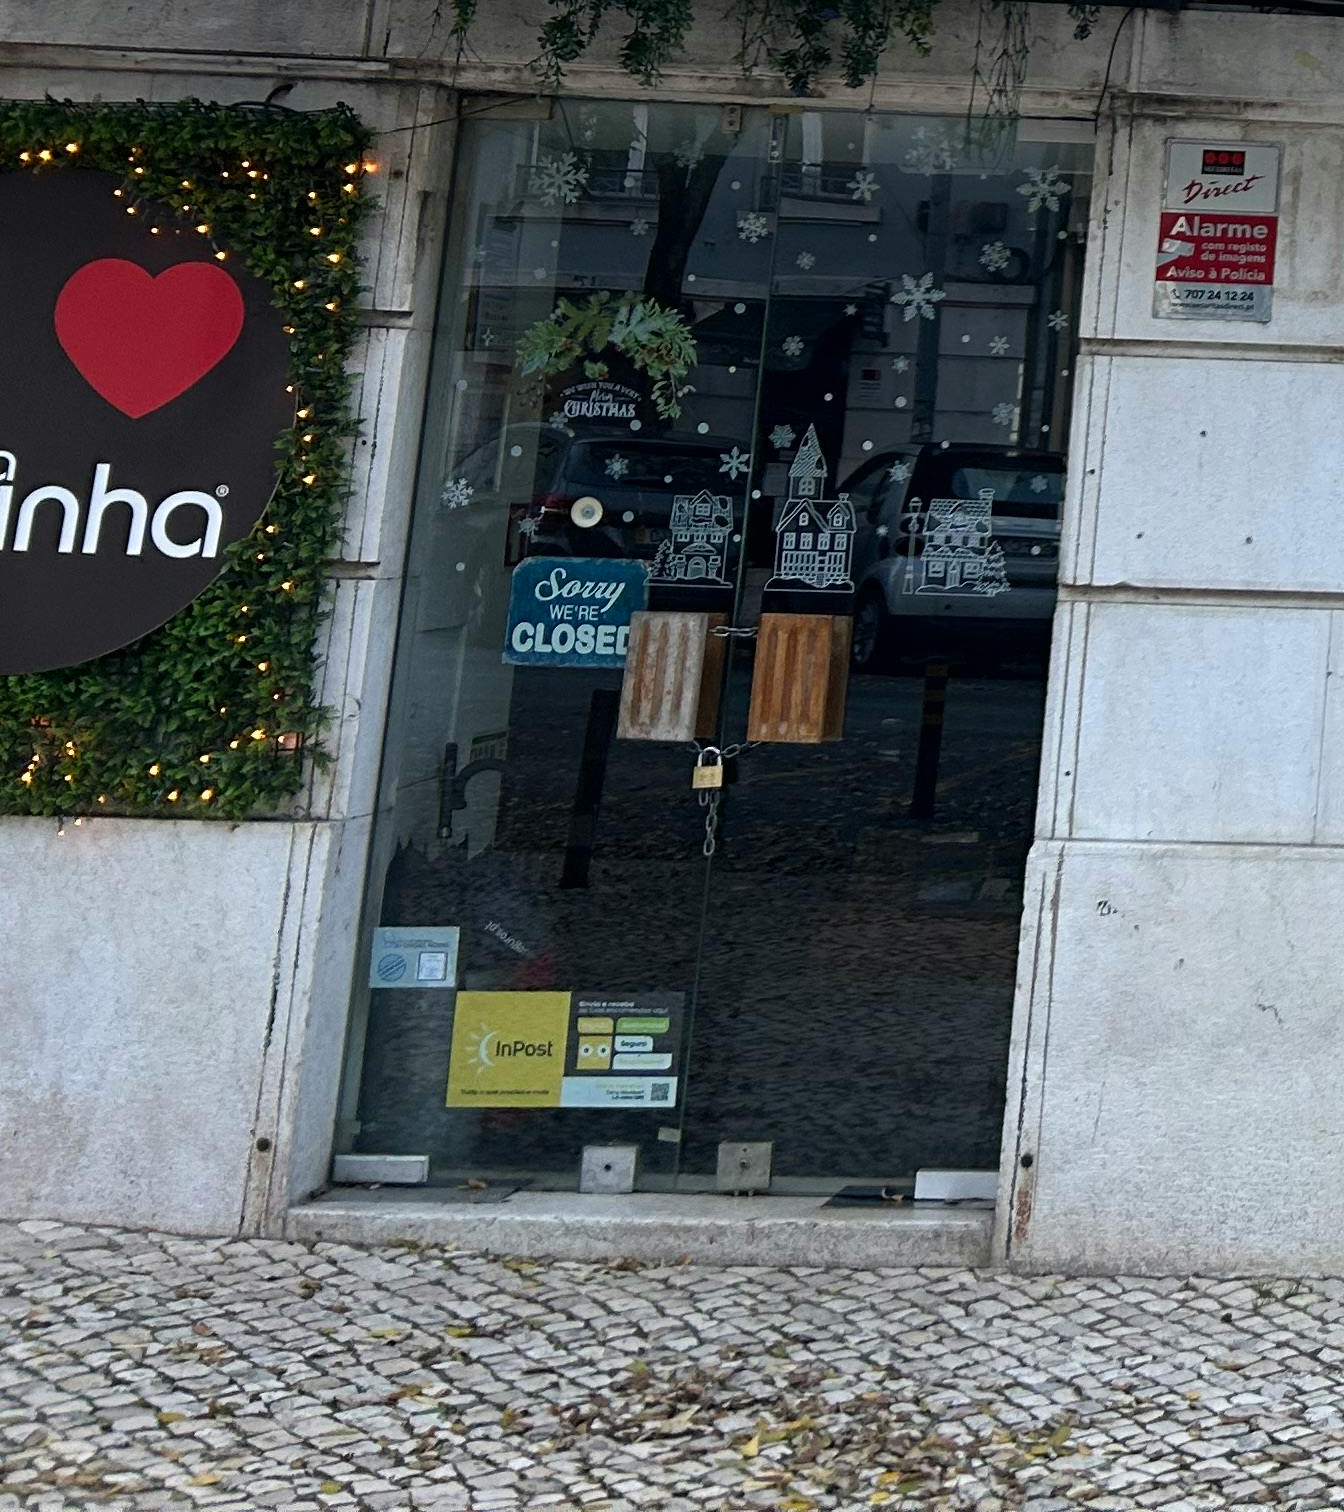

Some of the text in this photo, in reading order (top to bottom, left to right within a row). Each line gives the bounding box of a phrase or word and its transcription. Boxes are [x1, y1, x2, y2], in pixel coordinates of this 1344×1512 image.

[1181, 174, 1266, 204] Direct
[1169, 215, 1269, 239] Alarme
[1200, 242, 1267, 254] com registo
[1200, 251, 1266, 265] de imagens
[1166, 266, 1266, 281] Aviso à Polícia
[1184, 289, 1254, 302] 707 24 12 24
[563, 399, 636, 418] CHRISTMAS
[534, 567, 626, 613] Sorry
[550, 604, 600, 621] WE'RE
[511, 621, 631, 656] CLOSED
[495, 1040, 554, 1057] InPost
